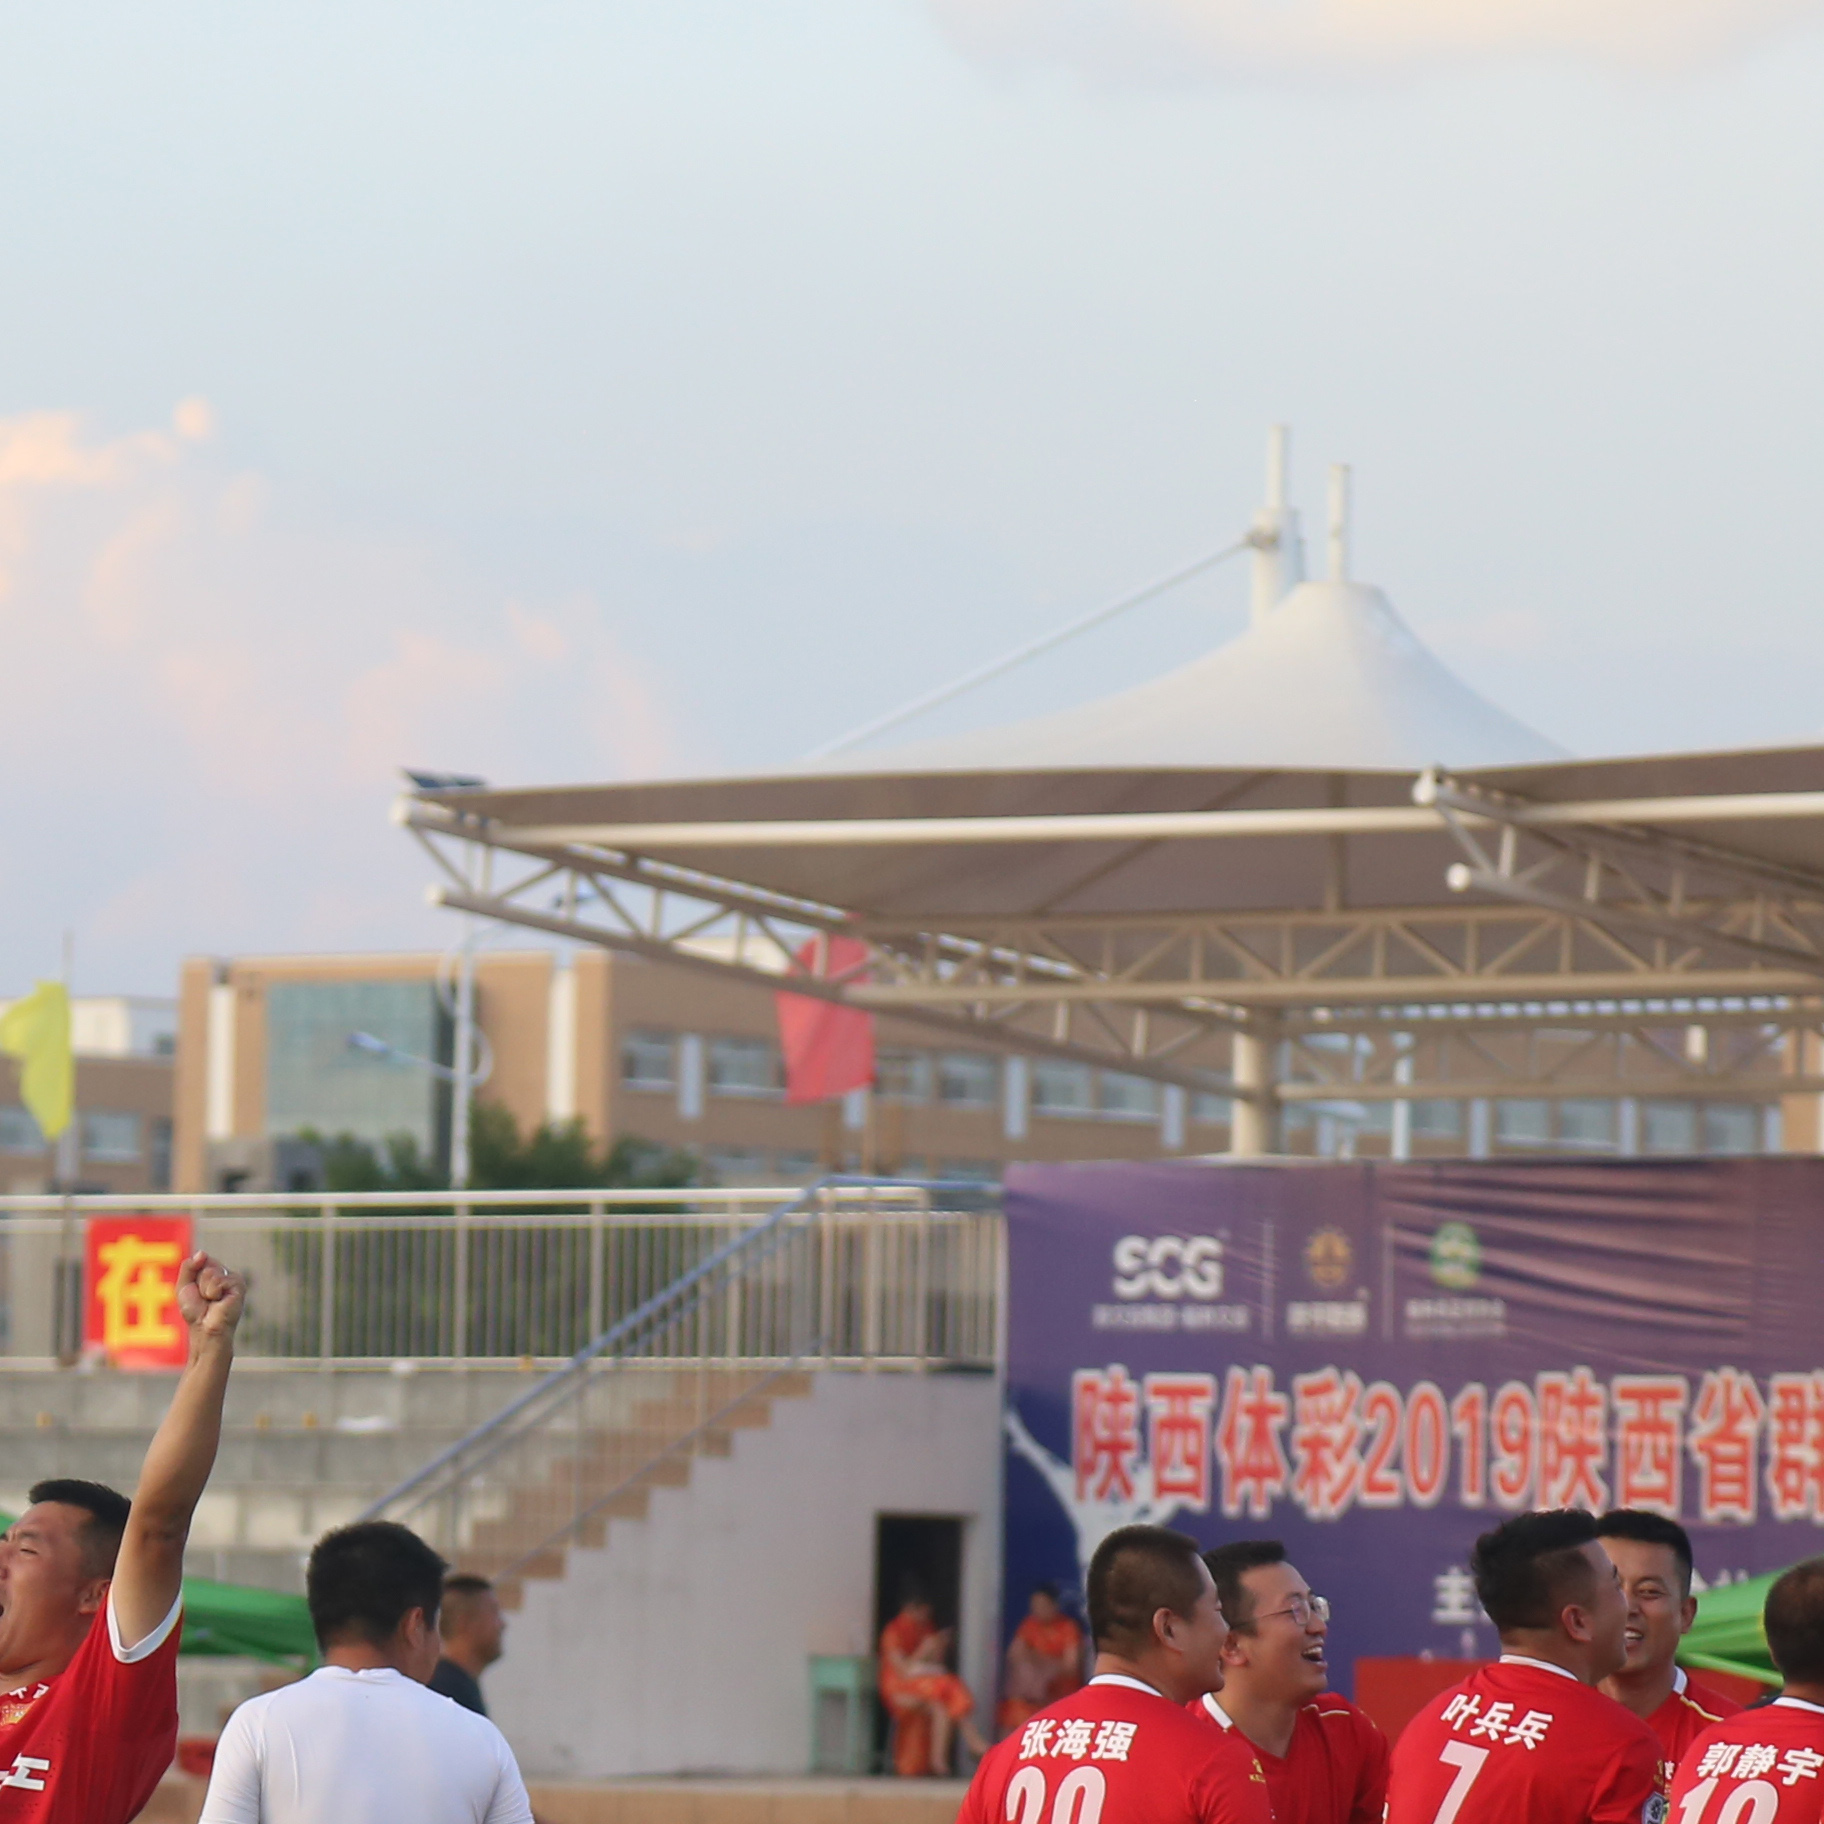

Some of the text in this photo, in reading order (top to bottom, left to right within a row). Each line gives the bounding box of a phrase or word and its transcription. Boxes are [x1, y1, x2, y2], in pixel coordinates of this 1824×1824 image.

[96, 1233, 182, 1352] 在
[1018, 1719, 1137, 1761] 张海强
[1440, 1693, 1553, 1750] 叶兵兵
[1697, 1741, 1824, 1786] 郭静宇
